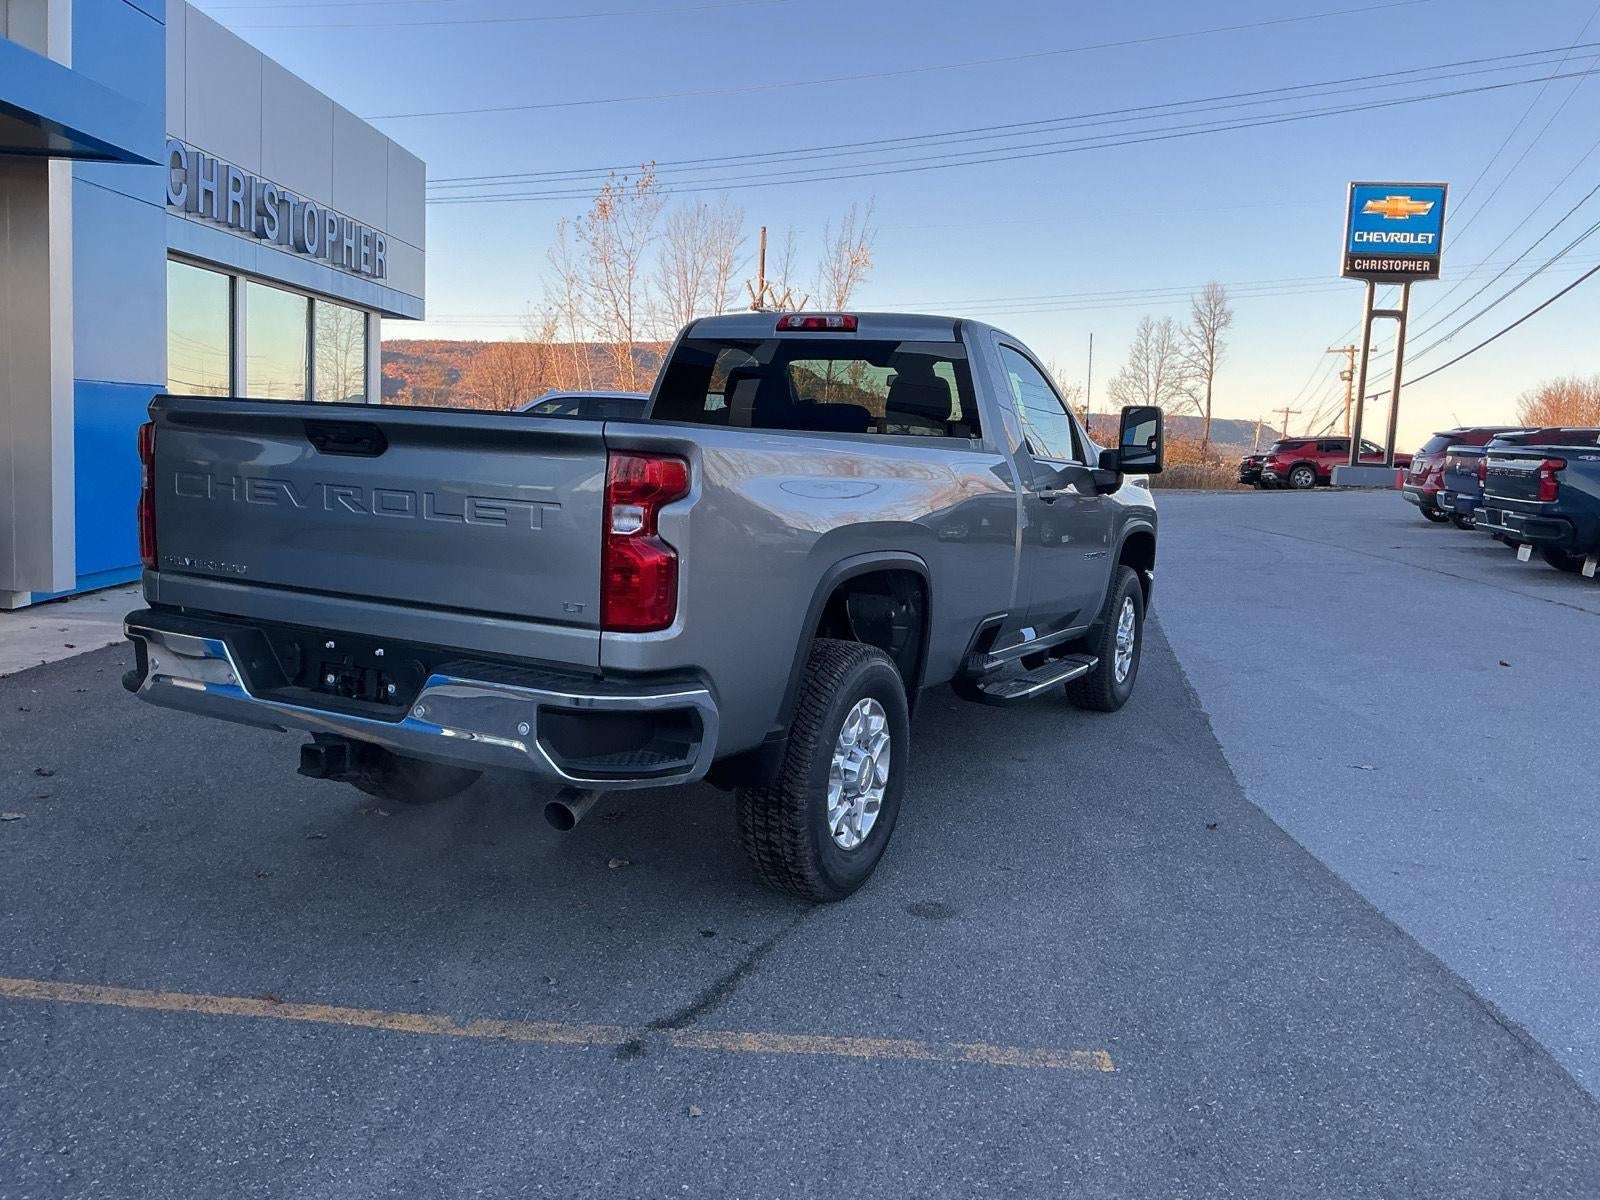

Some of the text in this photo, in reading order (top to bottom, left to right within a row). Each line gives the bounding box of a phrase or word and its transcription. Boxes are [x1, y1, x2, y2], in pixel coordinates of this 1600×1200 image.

[167, 139, 387, 279] CHRISTOPHER
[1354, 231, 1435, 244] CHEVROLET
[1354, 259, 1430, 271] CHRISTOPHER
[174, 471, 562, 530] CHEVROLET
[563, 601, 586, 614] LT
